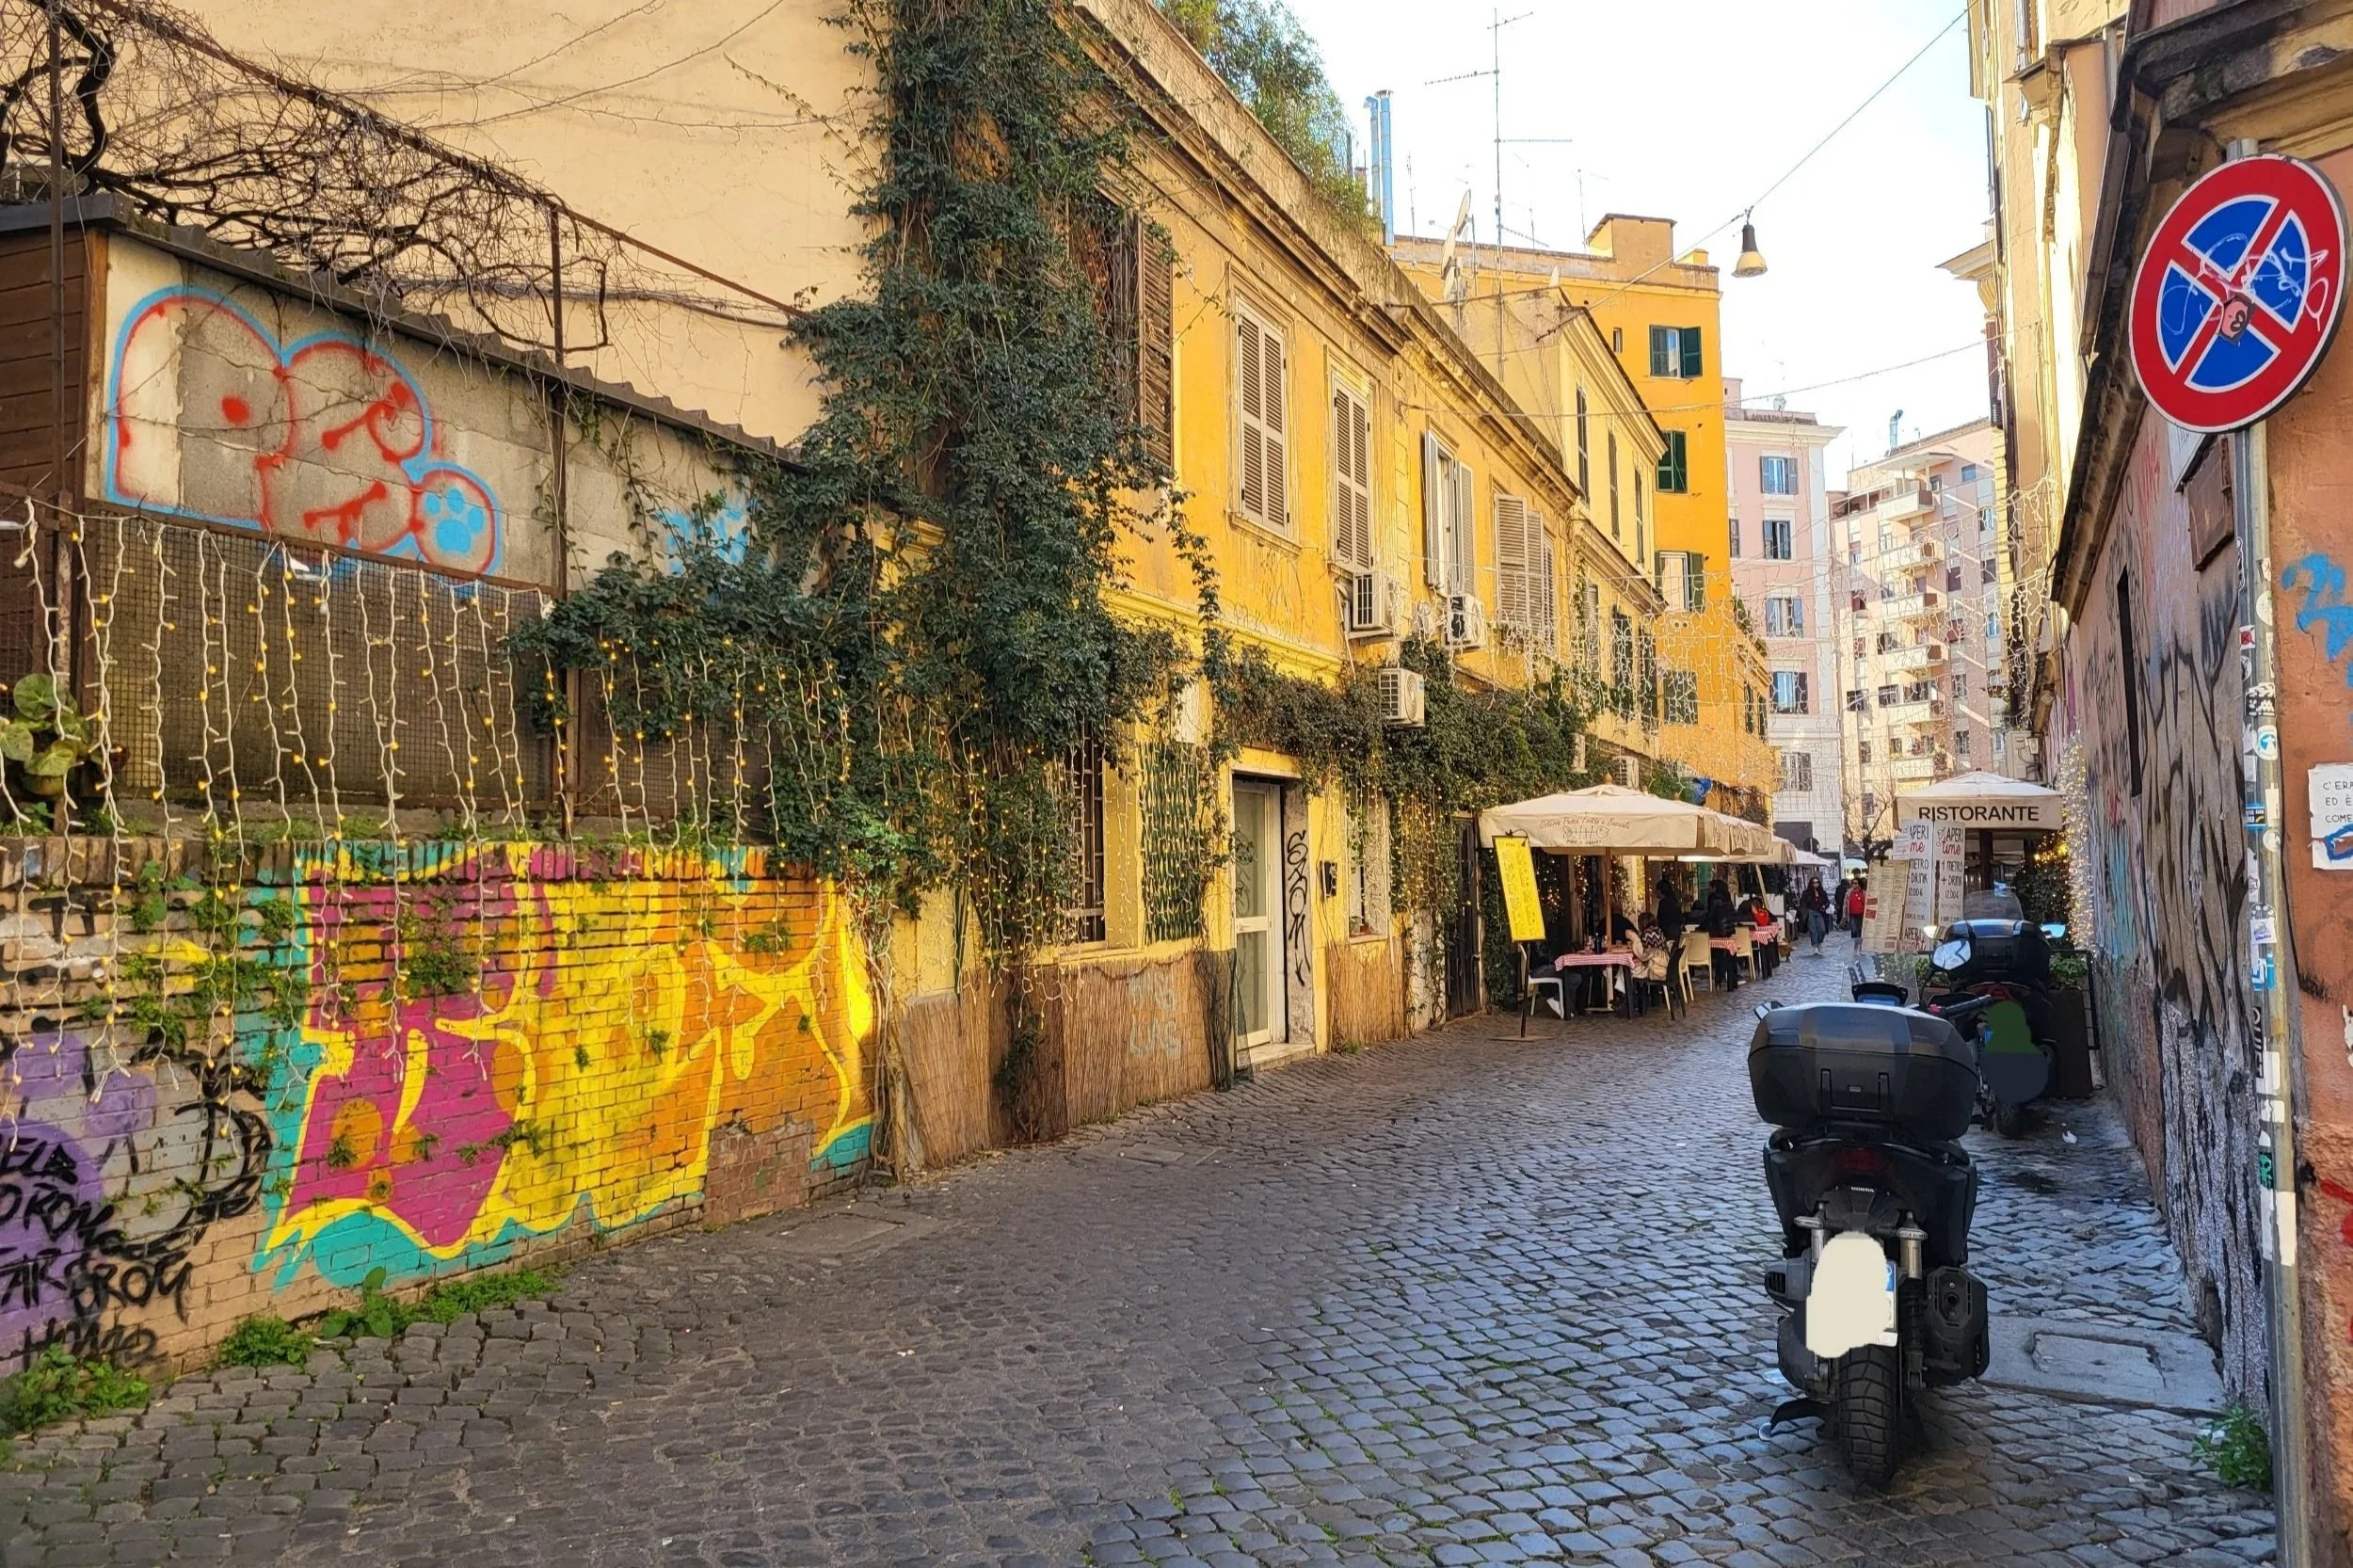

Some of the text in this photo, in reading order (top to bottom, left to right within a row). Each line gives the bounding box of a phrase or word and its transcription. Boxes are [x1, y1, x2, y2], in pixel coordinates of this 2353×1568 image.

[2325, 796, 2339, 807] ED
[1918, 806, 2040, 822] RISTORANTE
[2325, 813, 2353, 824] COME
[1945, 827, 1964, 843] APERI
[1942, 839, 1961, 856] time
[1946, 860, 1963, 873] METRO
